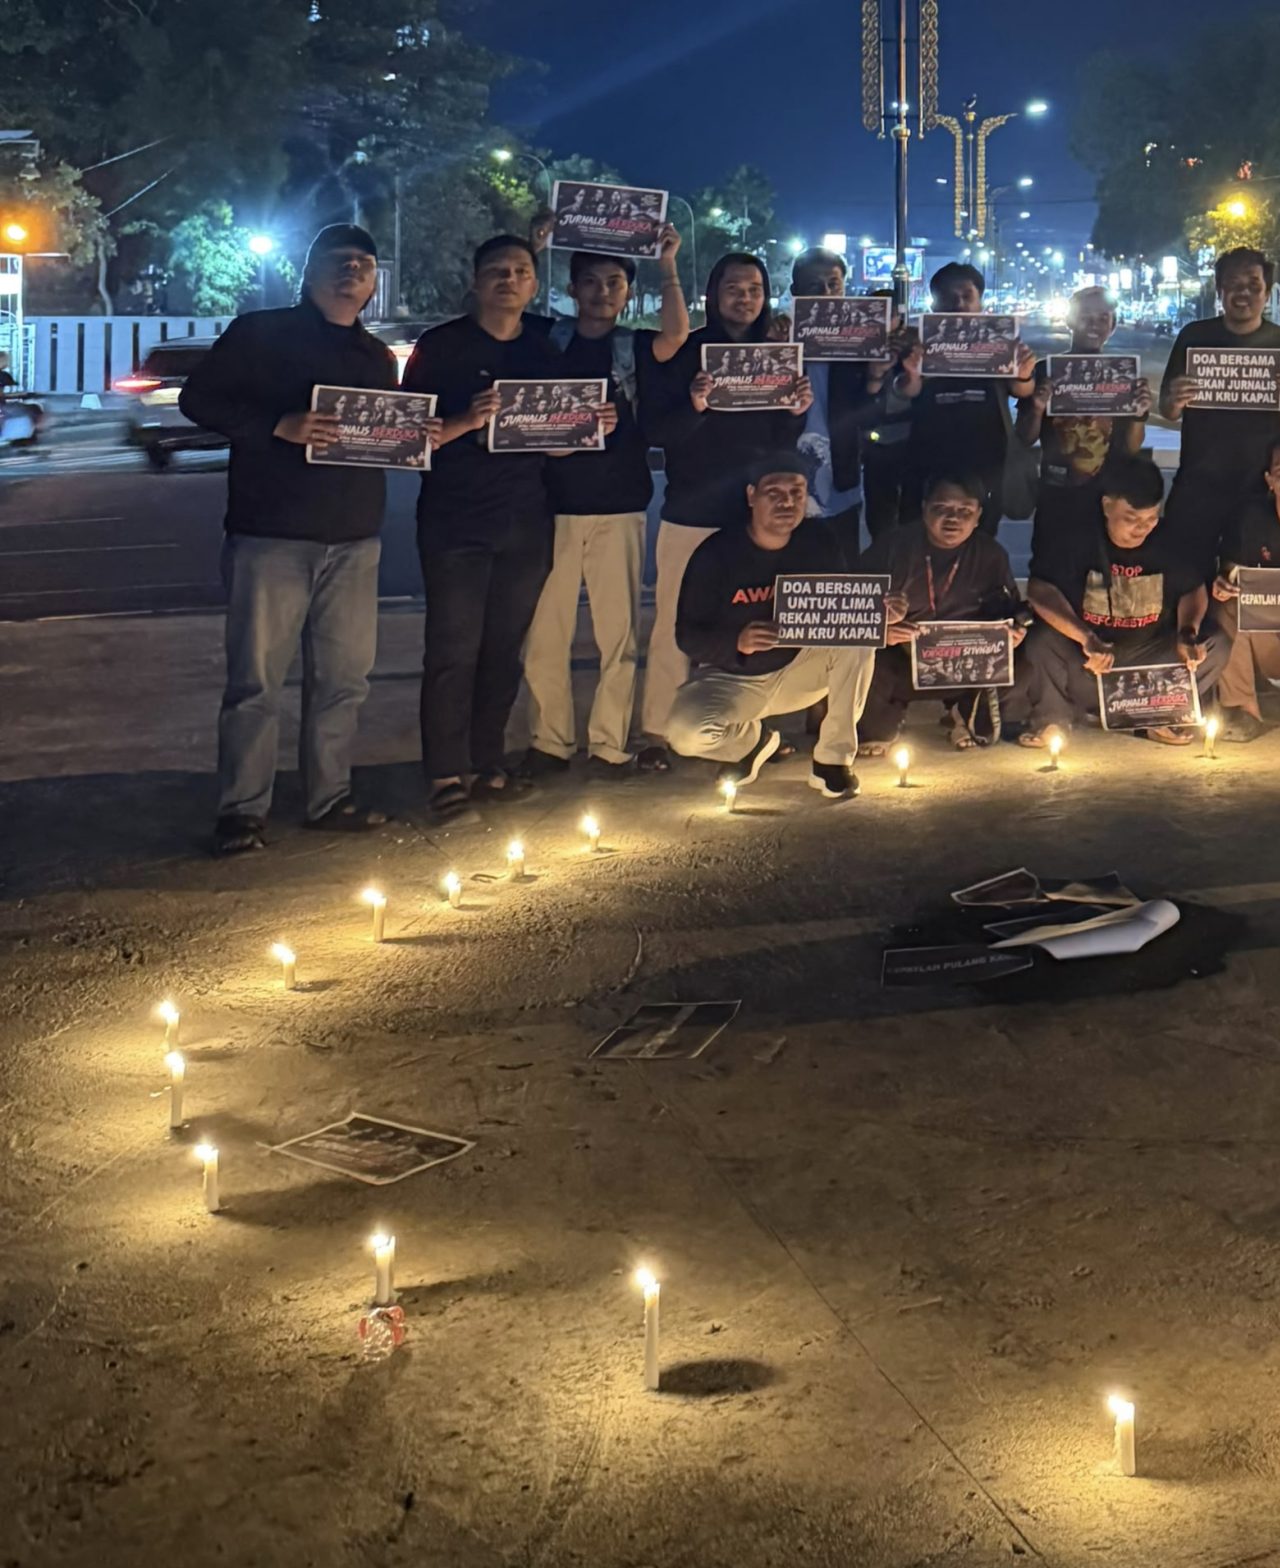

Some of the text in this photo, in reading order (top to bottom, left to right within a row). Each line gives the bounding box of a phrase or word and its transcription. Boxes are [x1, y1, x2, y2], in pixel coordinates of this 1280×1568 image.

[559, 214, 607, 226] JURNALIS
[798, 327, 840, 338] JURNALIS
[926, 342, 969, 354] JURNALIS
[1193, 354, 1276, 366] DOA BERSAMA
[1197, 366, 1271, 378] UNTUK LIMA
[712, 375, 753, 388] JURNALIS
[1227, 380, 1277, 391] JURNALIS
[1054, 383, 1094, 395] JURNALIS
[1216, 392, 1238, 402] KRU
[1242, 392, 1276, 403] KAPAL
[499, 413, 548, 428] JURNALIS
[1111, 563, 1142, 577] STOP
[782, 581, 882, 595] DOA BERSAMA
[787, 597, 875, 610] UNTUK LIMA
[1240, 594, 1276, 605] CEPATLAH
[778, 612, 882, 625] REKAN JURNALIS
[778, 626, 880, 640] DAN KRU KAPAL
[963, 640, 1005, 656] JURNALIS
[1108, 696, 1149, 713] JURNALIS
[943, 956, 987, 970] PULANG
